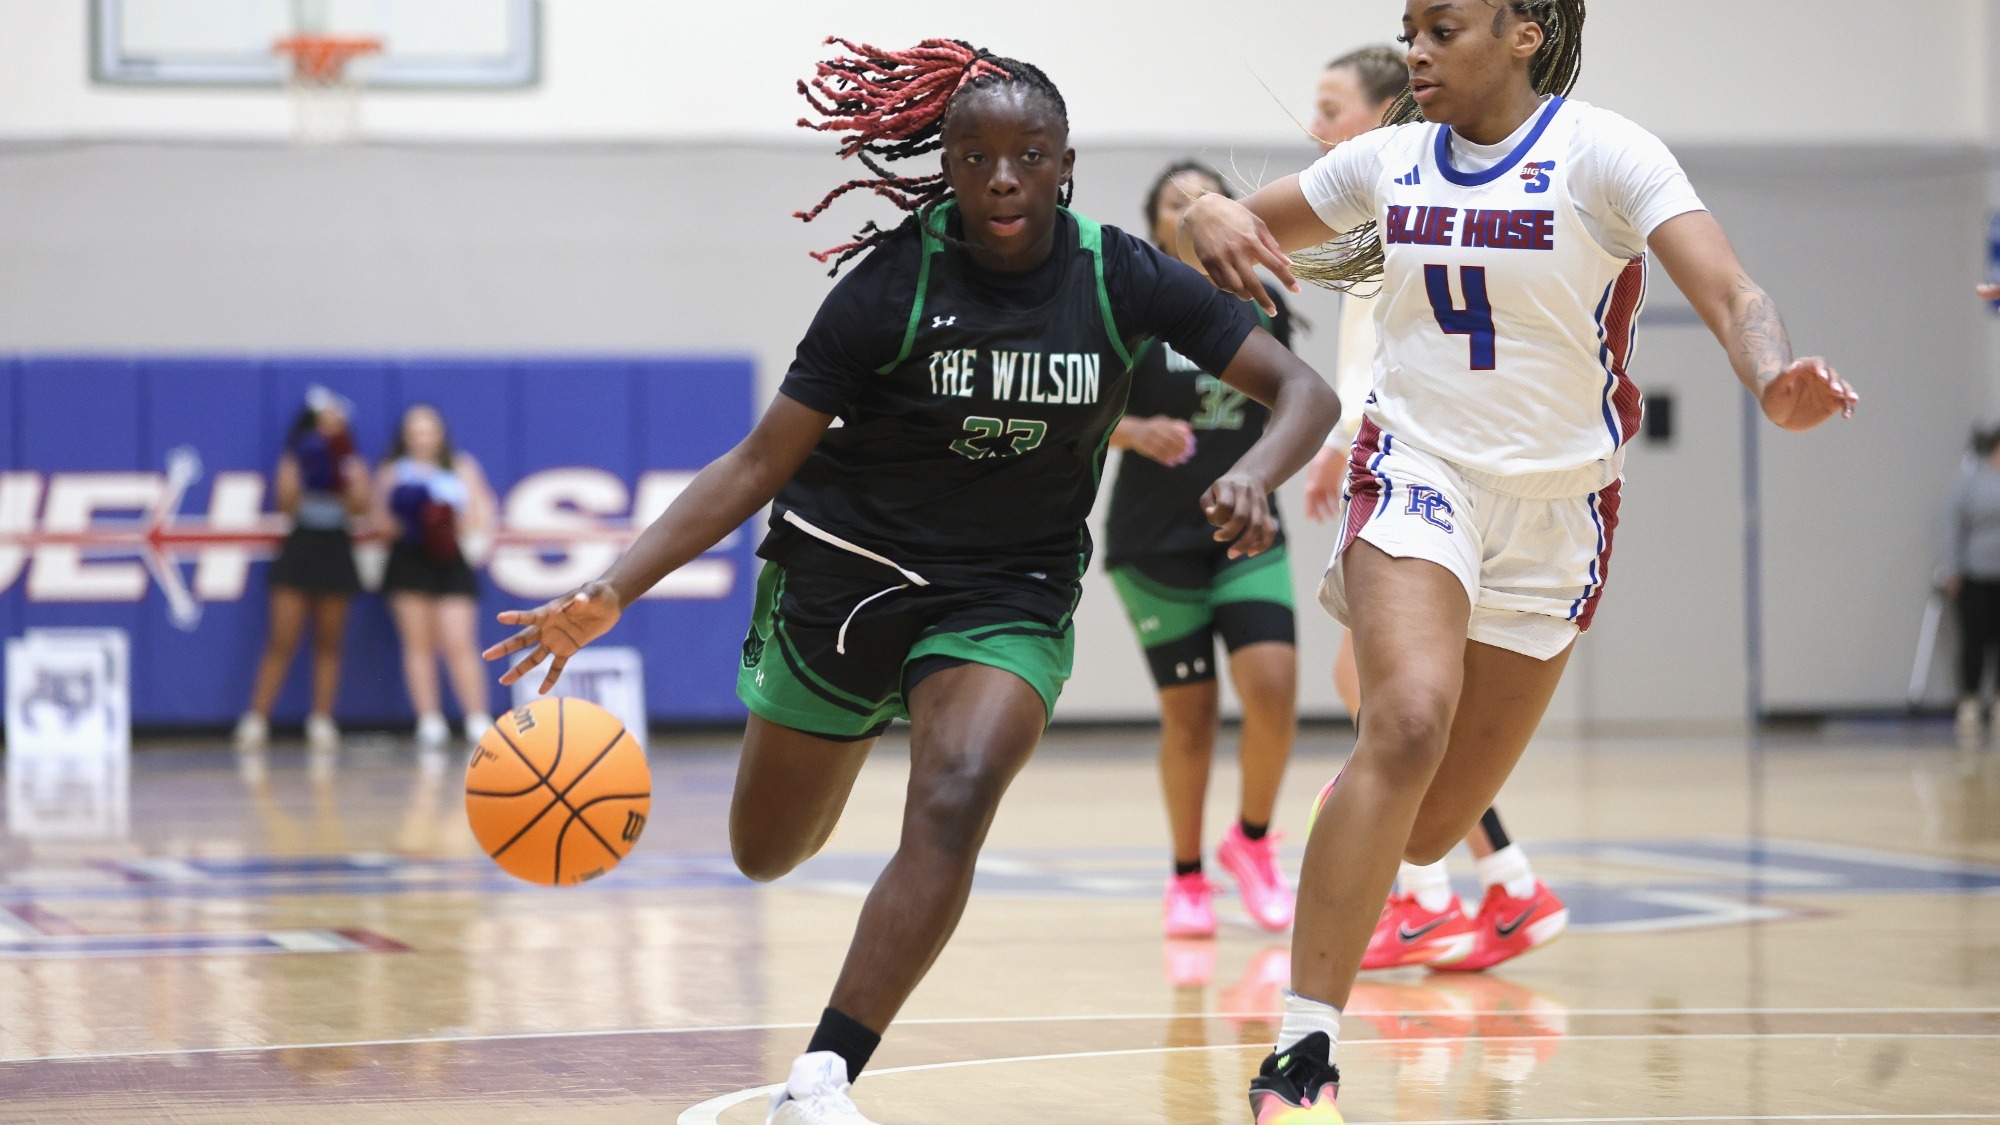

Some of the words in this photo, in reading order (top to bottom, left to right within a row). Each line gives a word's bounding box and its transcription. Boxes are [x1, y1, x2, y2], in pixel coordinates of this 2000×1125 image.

[1520, 166, 1541, 176] BIG
[1386, 204, 1458, 247] BLUE
[1460, 208, 1554, 251] HOSE
[1423, 263, 1496, 371] 4
[928, 348, 978, 398] THE
[990, 350, 1100, 405] WILSON
[948, 415, 1048, 460] 23
